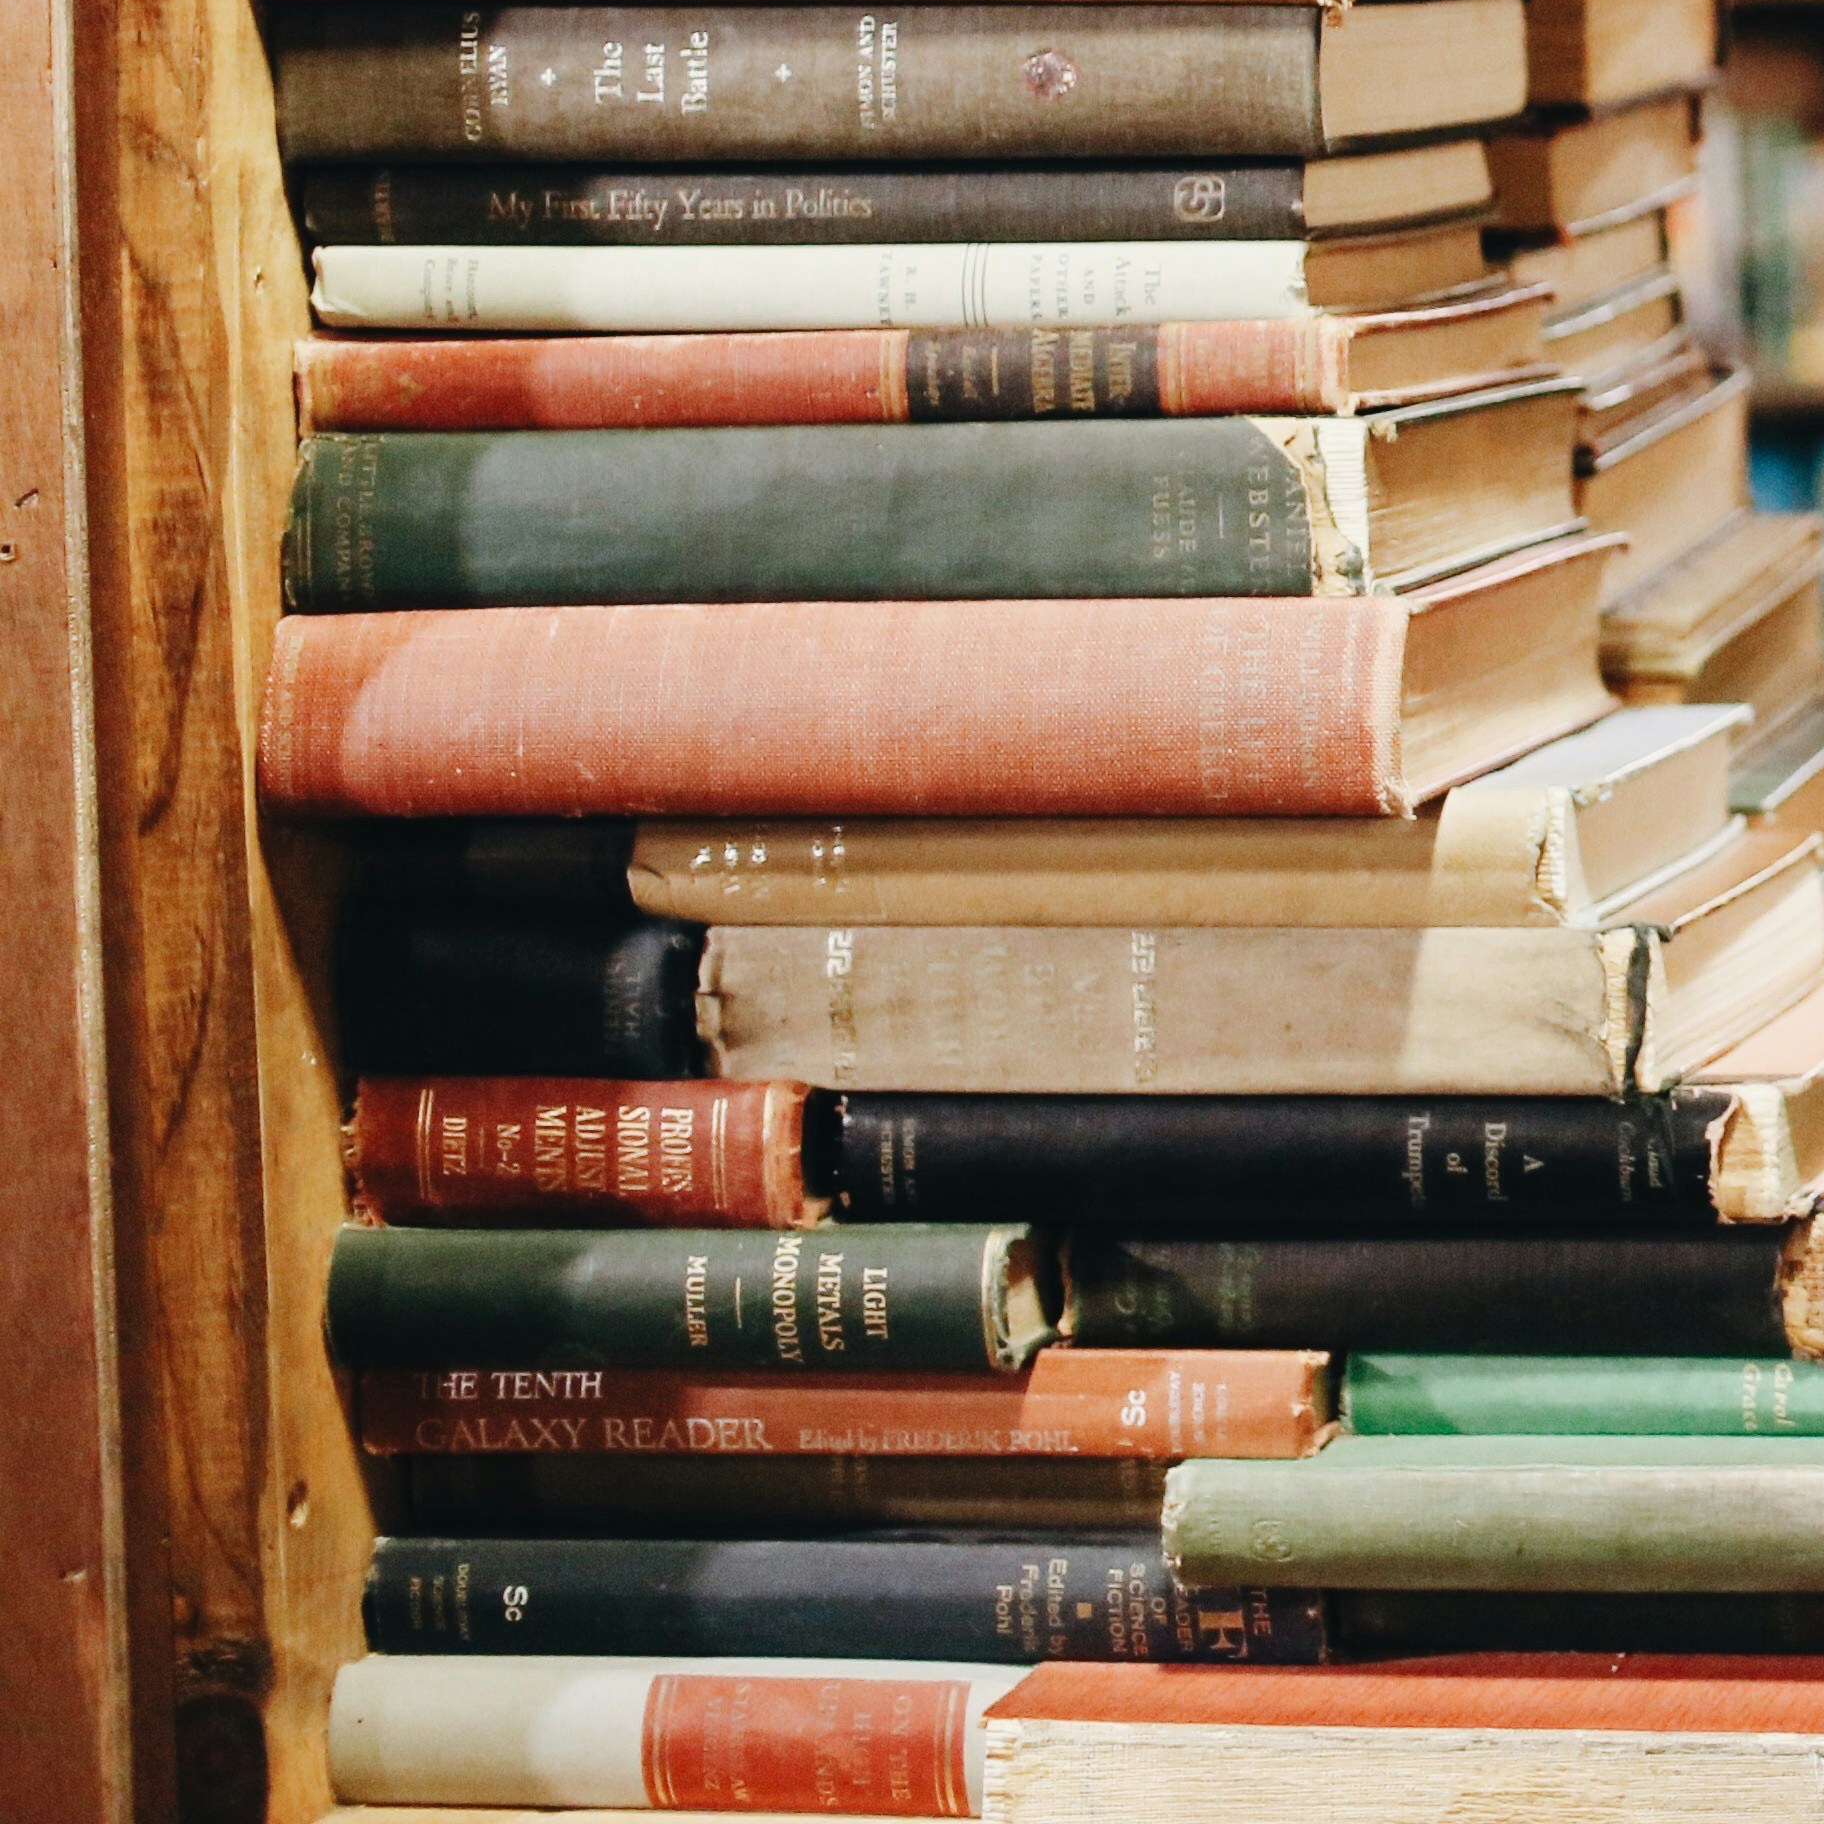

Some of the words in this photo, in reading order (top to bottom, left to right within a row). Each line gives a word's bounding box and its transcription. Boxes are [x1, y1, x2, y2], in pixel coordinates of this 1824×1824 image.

[594, 40, 624, 105] The
[636, 43, 666, 103] Last
[680, 30, 710, 117] Battle
[487, 190, 534, 230] My
[543, 189, 601, 221] First
[607, 187, 670, 231] Fifty
[677, 188, 747, 221] Years
[753, 189, 778, 218] in
[785, 187, 874, 219] Politics
[533, 1103, 568, 1192] MENTS
[615, 1105, 651, 1198] SIONAL
[1482, 1121, 1507, 1203] Discord
[1522, 1153, 1545, 1175] A
[684, 1253, 709, 1349] MULLER
[772, 1234, 801, 1364] MONOPOLY
[818, 1251, 846, 1353] METALS
[863, 1264, 887, 1342] LIGHT
[491, 1369, 604, 1400] TENTH
[414, 1415, 591, 1452] GALAXY
[603, 1415, 773, 1452] READER
[880, 1428, 1003, 1453] FREDERIK
[1008, 1430, 1080, 1453] POHL
[501, 1582, 531, 1623] Sc
[994, 1581, 1014, 1636] Pohl
[1107, 1565, 1126, 1654] FICTION
